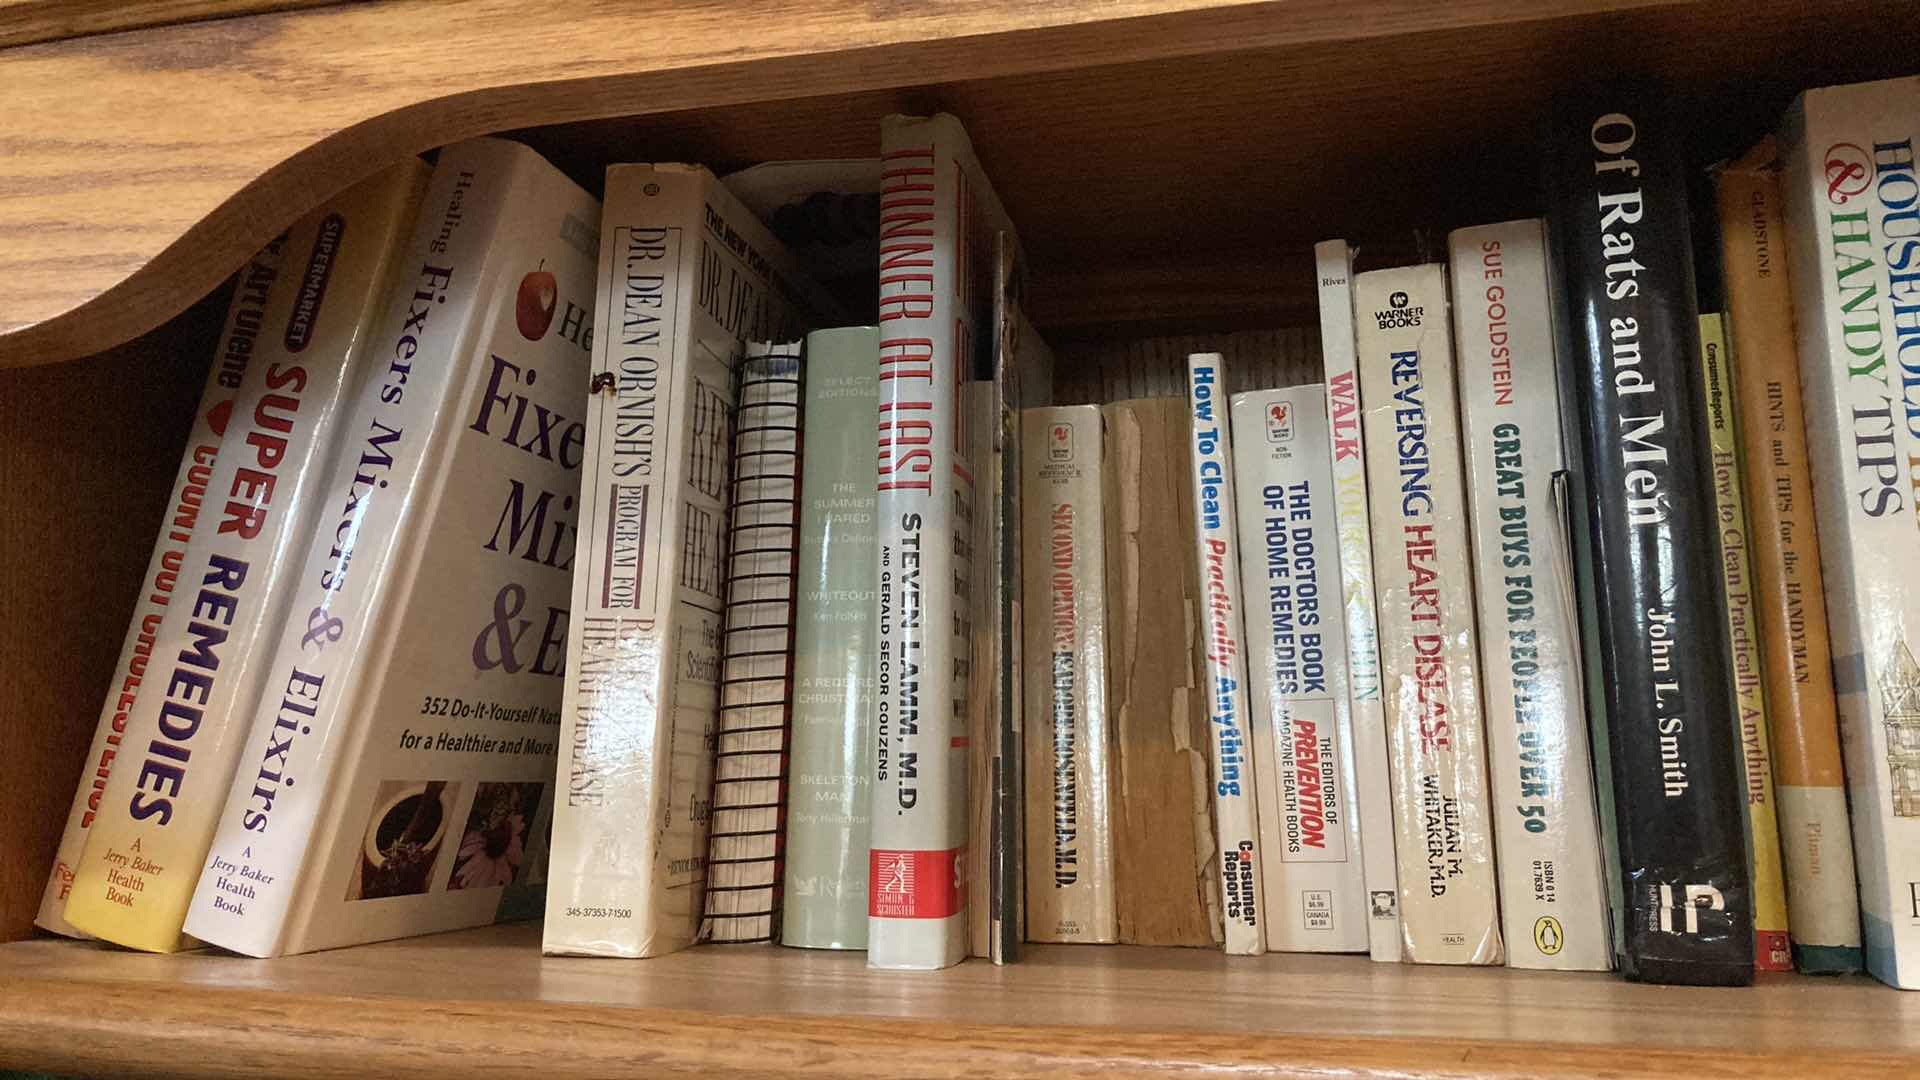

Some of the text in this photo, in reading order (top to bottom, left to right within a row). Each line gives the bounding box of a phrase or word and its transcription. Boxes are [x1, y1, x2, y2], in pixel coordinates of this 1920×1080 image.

[1322, 276, 1346, 287] Rives
[1375, 307, 1424, 320] WARNER
[878, 144, 935, 497] THINNER AT LAST
[1379, 316, 1421, 330] BOOKS
[1483, 241, 1513, 406] SUE GOLDSTEIN
[1591, 113, 1670, 527] Of Rats and Men
[1823, 142, 1905, 518] & HANDY TIPS
[611, 225, 667, 486] DR. DEAN ORNISH'S
[1328, 371, 1358, 462] WALK
[129, 223, 338, 827] SUPERMARKET SUPER REMEDIES
[242, 170, 475, 834] Healing Fixers Mixers & Elixirs
[613, 485, 641, 577] PROGRAM
[825, 512, 871, 523] ARED
[1052, 503, 1074, 569] SECOND
[1767, 381, 1810, 684] HINTS and TIPS for the HANDYMAN
[1193, 367, 1245, 798] How To Clean Practically Anything
[1289, 480, 1325, 693] THE DOCTORS BOOK
[1390, 350, 1452, 756] REVERSING HEART DISEASE
[609, 580, 637, 609] FOR
[807, 591, 875, 601] WHITEOUT
[880, 571, 891, 635] GERALD
[1052, 572, 1075, 644] OPINION
[1263, 485, 1298, 695] OF HOME REMEDIES
[472, 583, 532, 676] &
[1493, 423, 1548, 834] GREAT BUYS FOR PEOPLE OVER 50
[1714, 451, 1768, 805] How to Clean Practically Anything
[816, 678, 875, 688] REDBRD
[879, 640, 889, 696] SECOR
[897, 512, 921, 816] STEVEN LAMM, M.D.
[421, 696, 538, 725] 352 Do-It-Yourself
[799, 694, 874, 704] CHRISTAS
[1648, 608, 1688, 798] John L. Smith
[399, 729, 555, 756] for a Healthier and More
[878, 699, 889, 782] COUZENS
[800, 774, 869, 785] SKELETON
[816, 792, 849, 801] MAN
[1278, 709, 1300, 853] MAGAZINE HEALTH BOOKS
[1293, 719, 1325, 849] PREVENTION
[1320, 737, 1337, 825] THE EDITORS OF
[104, 848, 164, 876] Jerry Baker
[130, 838, 141, 852] A
[211, 855, 275, 886] Jerry Baker
[242, 846, 252, 858] A
[1442, 795, 1463, 878] JULIAN M.
[106, 887, 135, 908] Book
[107, 869, 145, 892] Health
[215, 876, 257, 900] Health
[1222, 851, 1240, 918] Reports
[1238, 840, 1256, 927] Consumer
[1429, 865, 1446, 898] M.D.
[1544, 860, 1554, 884] ISBN
[213, 896, 246, 918] Book
